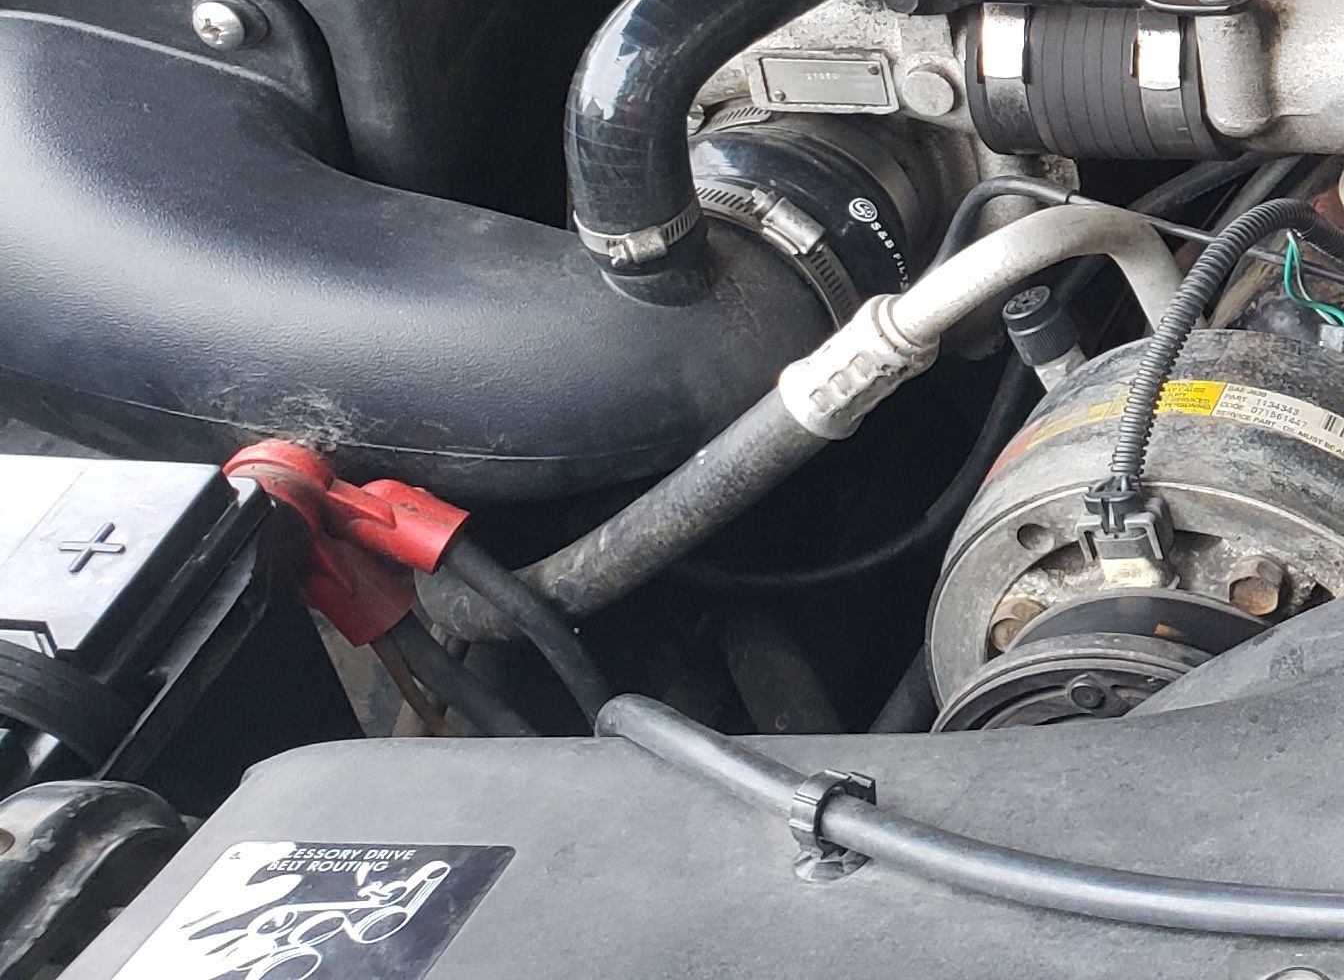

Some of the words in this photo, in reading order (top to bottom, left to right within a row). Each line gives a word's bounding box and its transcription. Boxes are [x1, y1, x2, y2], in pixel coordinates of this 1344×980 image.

[1224, 394, 1247, 403] PART
[1220, 401, 1246, 411] CODE
[1298, 431, 1324, 445] MUST
[363, 849, 417, 861] DRIVE
[267, 860, 306, 872] BELT
[306, 860, 389, 872] ROUTING
